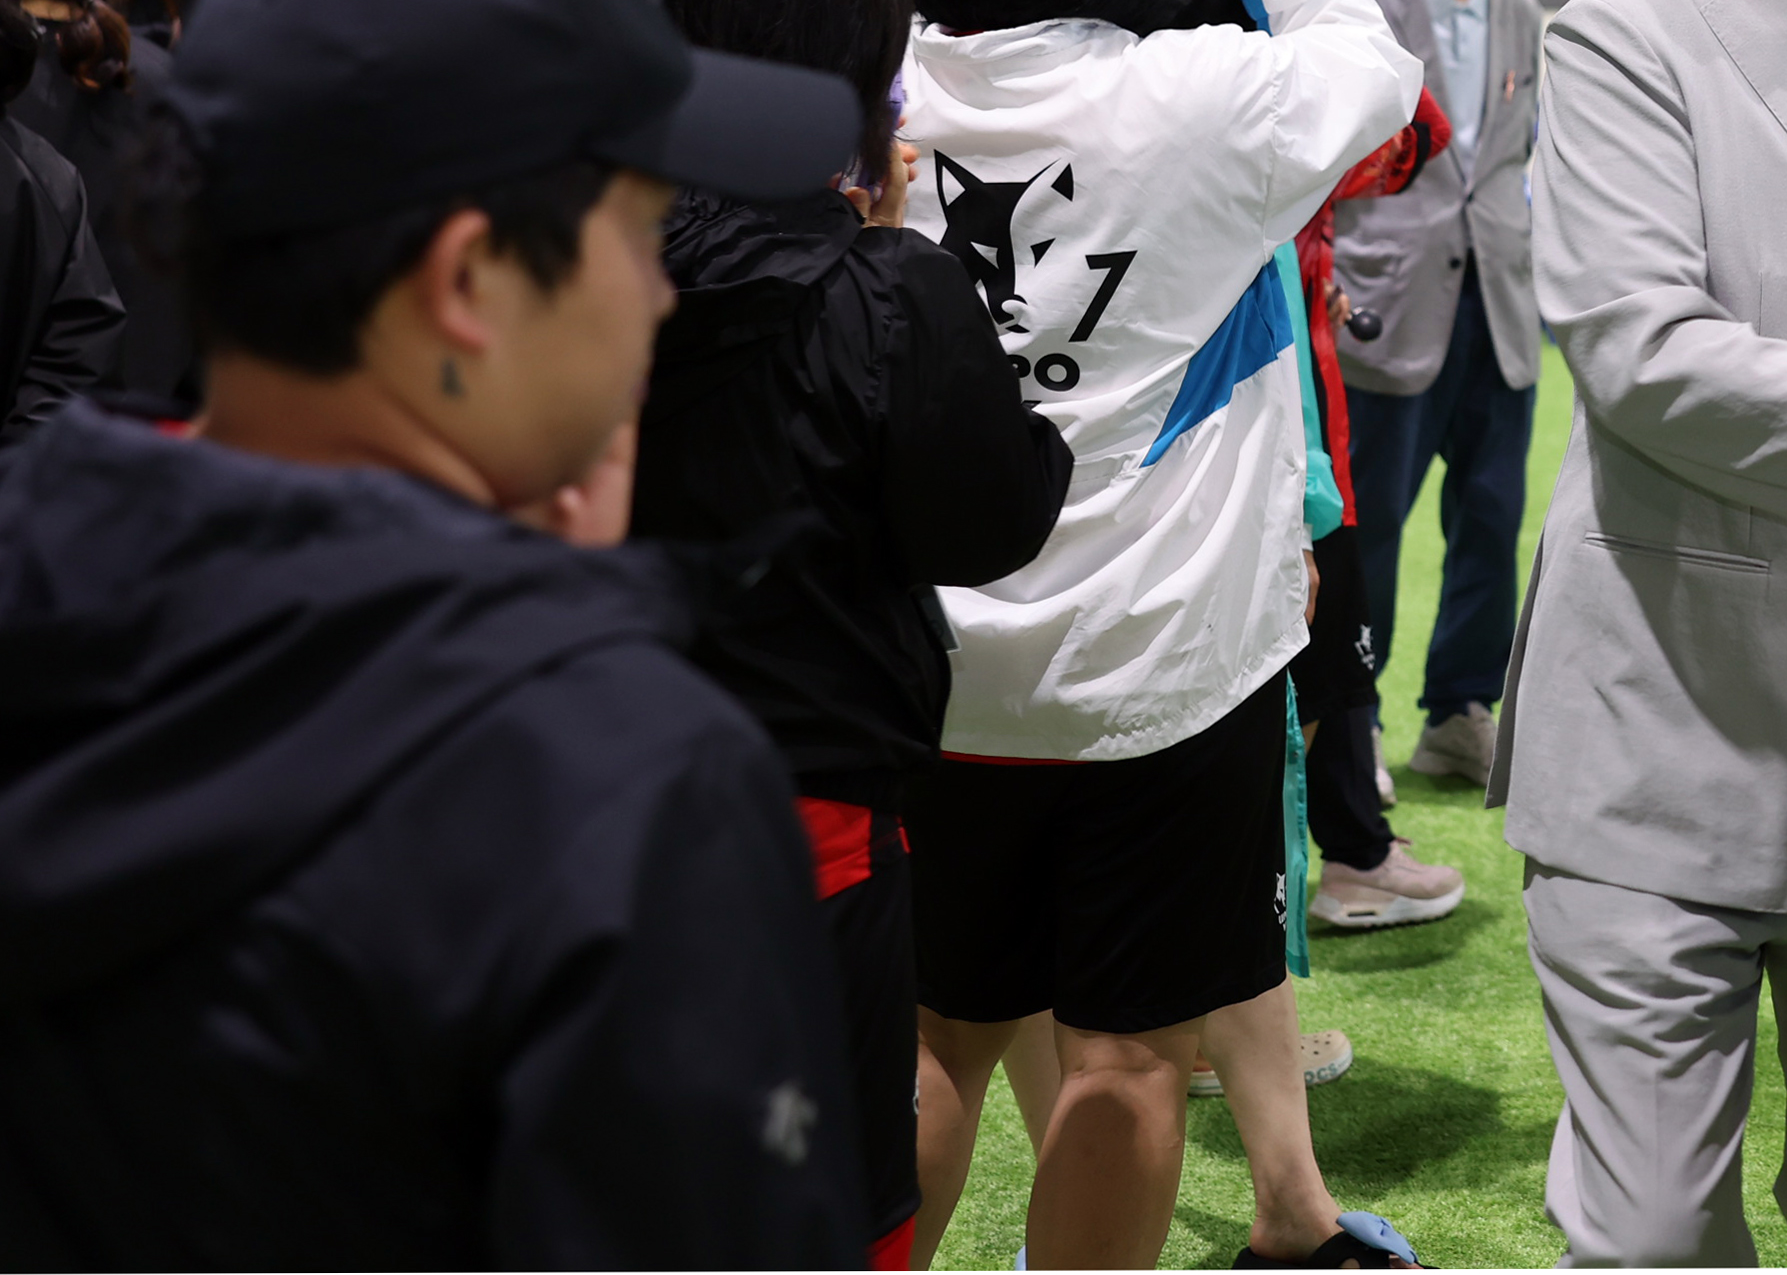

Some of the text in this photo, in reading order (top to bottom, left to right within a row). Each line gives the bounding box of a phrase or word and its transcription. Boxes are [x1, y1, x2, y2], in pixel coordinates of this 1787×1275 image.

[1068, 250, 1138, 342] 7
[1007, 353, 1081, 392] PO
[1304, 1063, 1338, 1084] OCS
